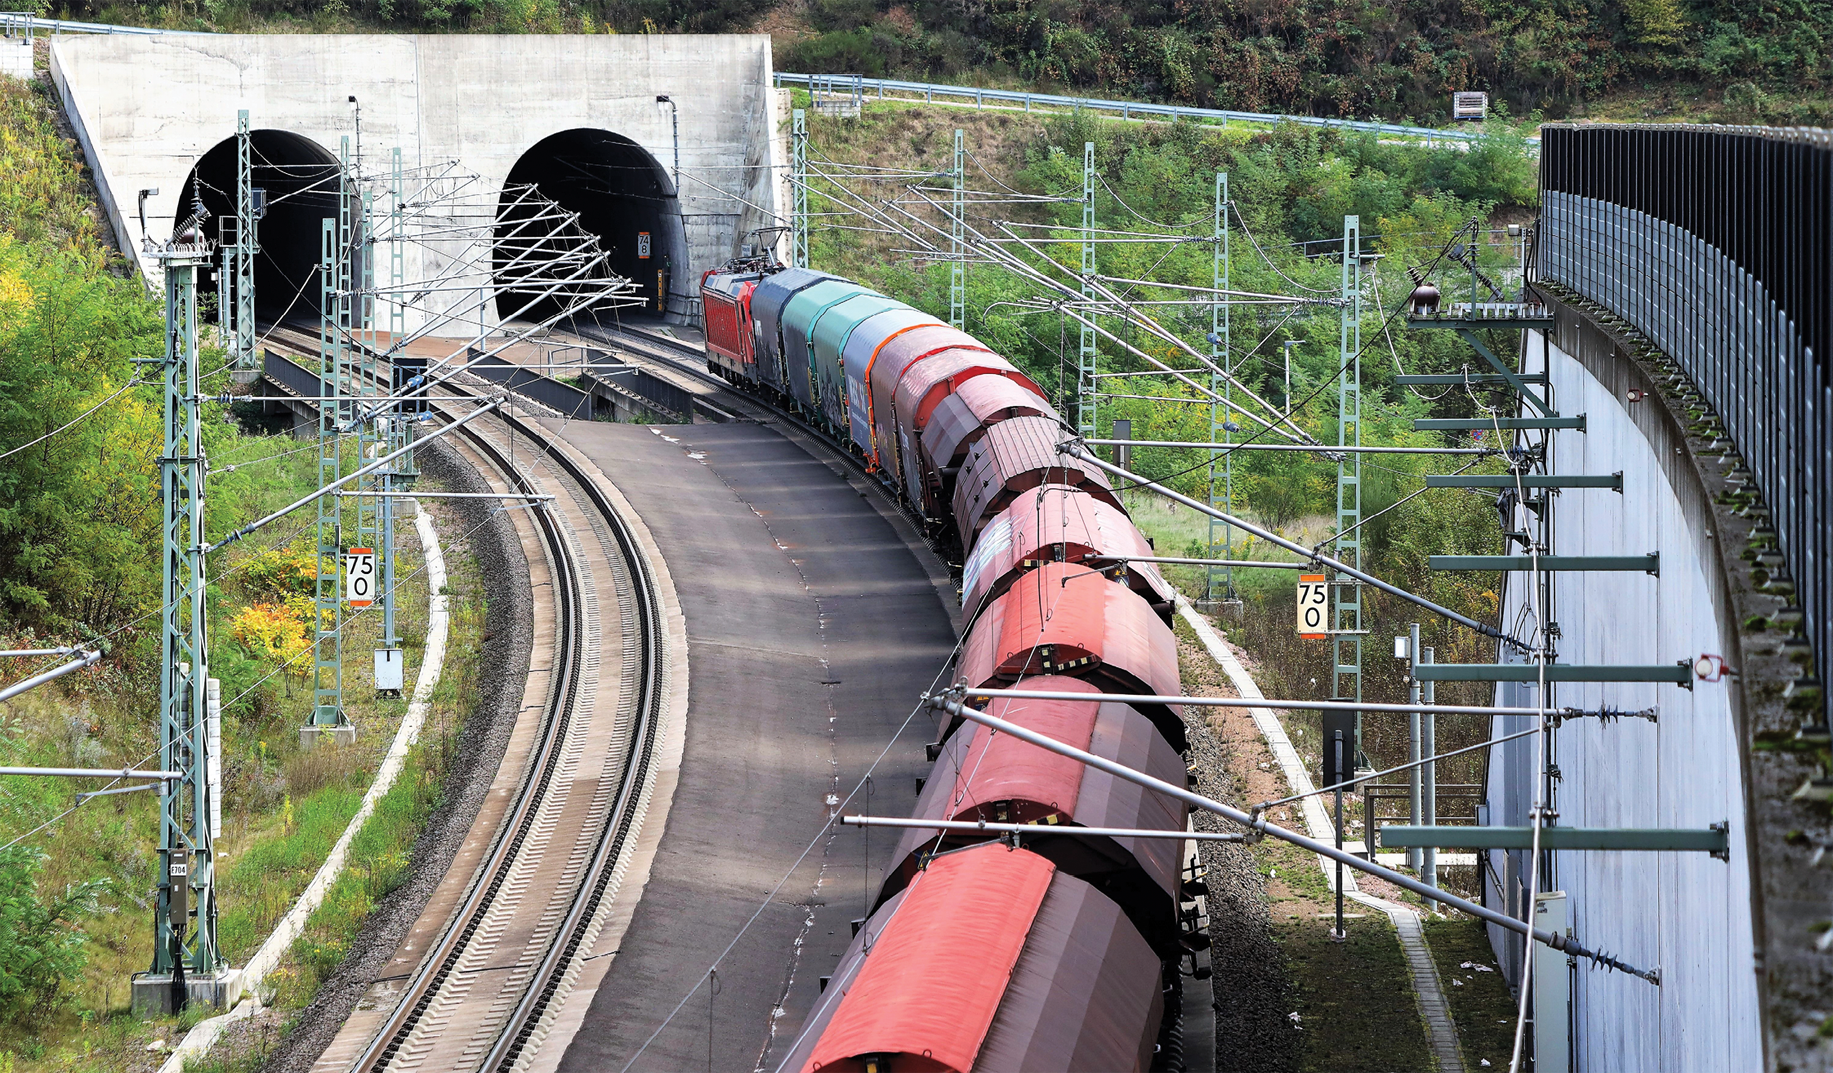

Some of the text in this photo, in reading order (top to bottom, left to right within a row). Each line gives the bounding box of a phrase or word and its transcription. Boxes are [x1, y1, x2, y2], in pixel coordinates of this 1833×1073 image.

[639, 236, 649, 244] 74
[641, 245, 648, 254] 8
[348, 556, 373, 575] 75
[354, 577, 368, 596] 0
[1299, 585, 1326, 605] 75
[1305, 607, 1321, 628] 0
